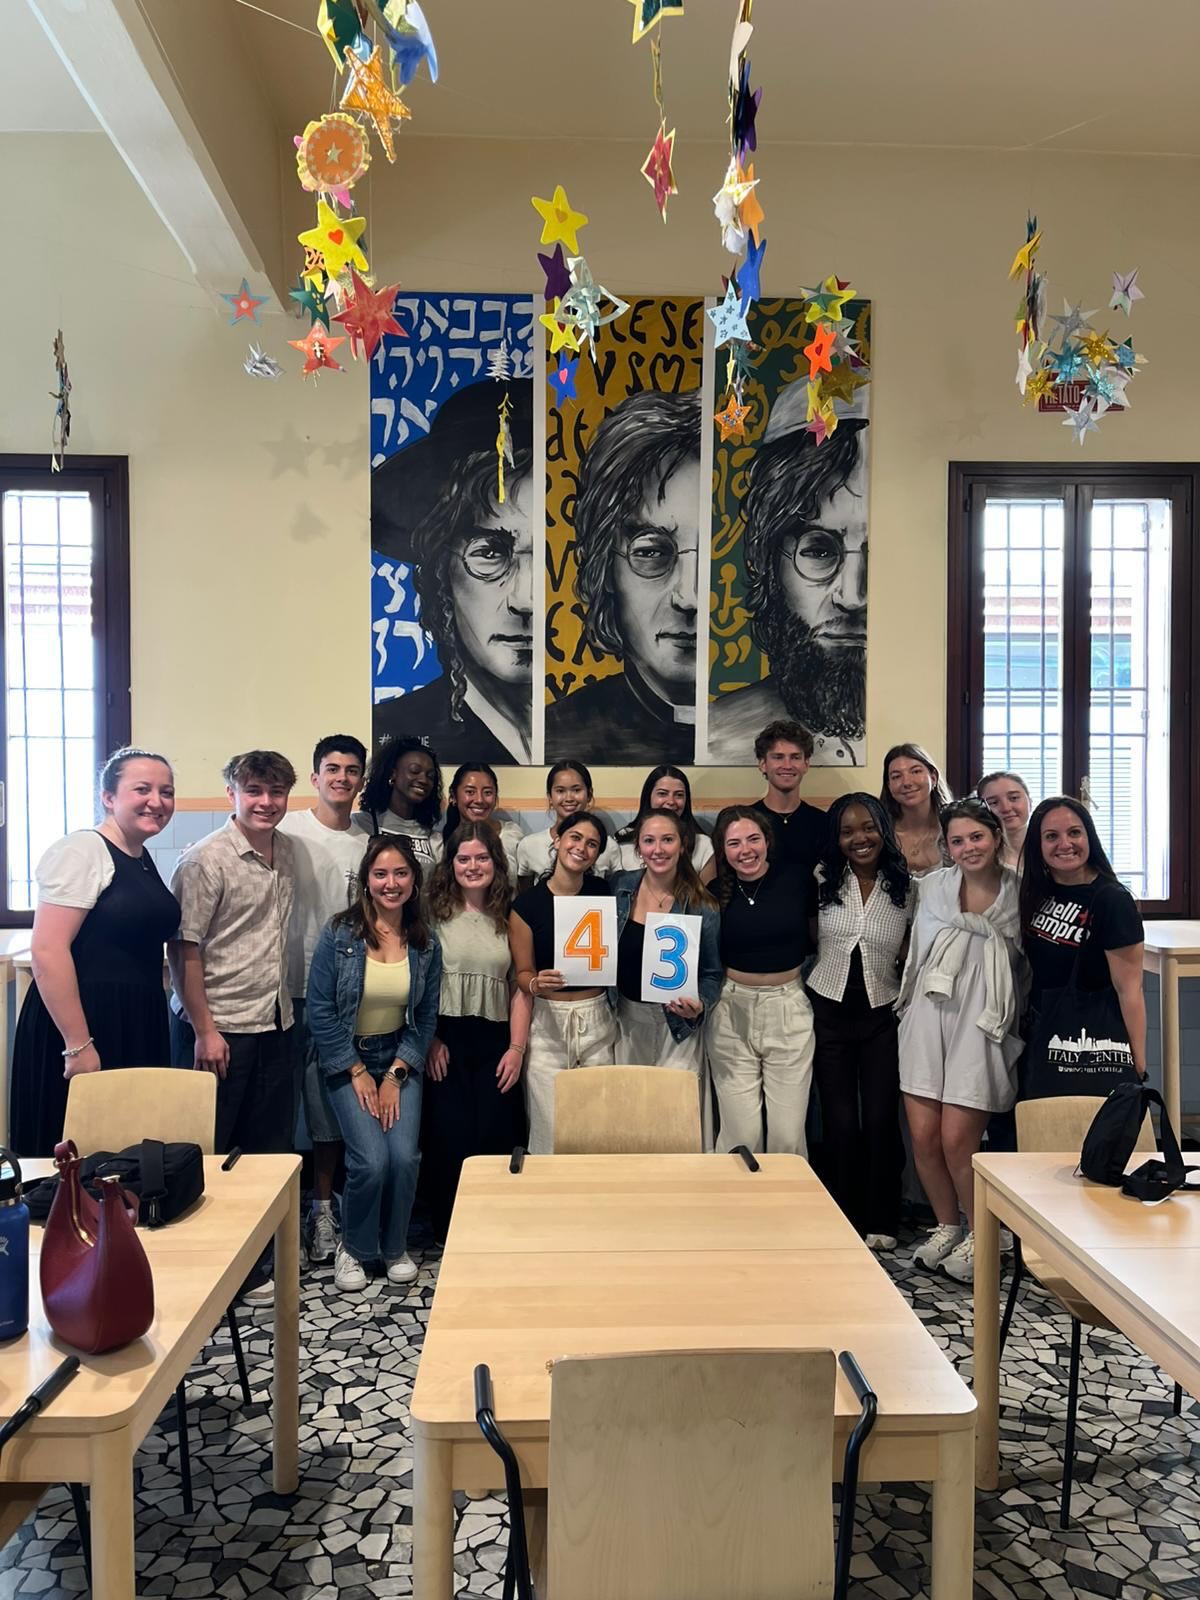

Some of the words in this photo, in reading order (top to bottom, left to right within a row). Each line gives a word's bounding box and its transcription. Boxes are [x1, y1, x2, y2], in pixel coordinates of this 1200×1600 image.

[563, 909, 609, 971] 4
[650, 925, 689, 990] 3
[1048, 1049, 1082, 1063] ITALY
